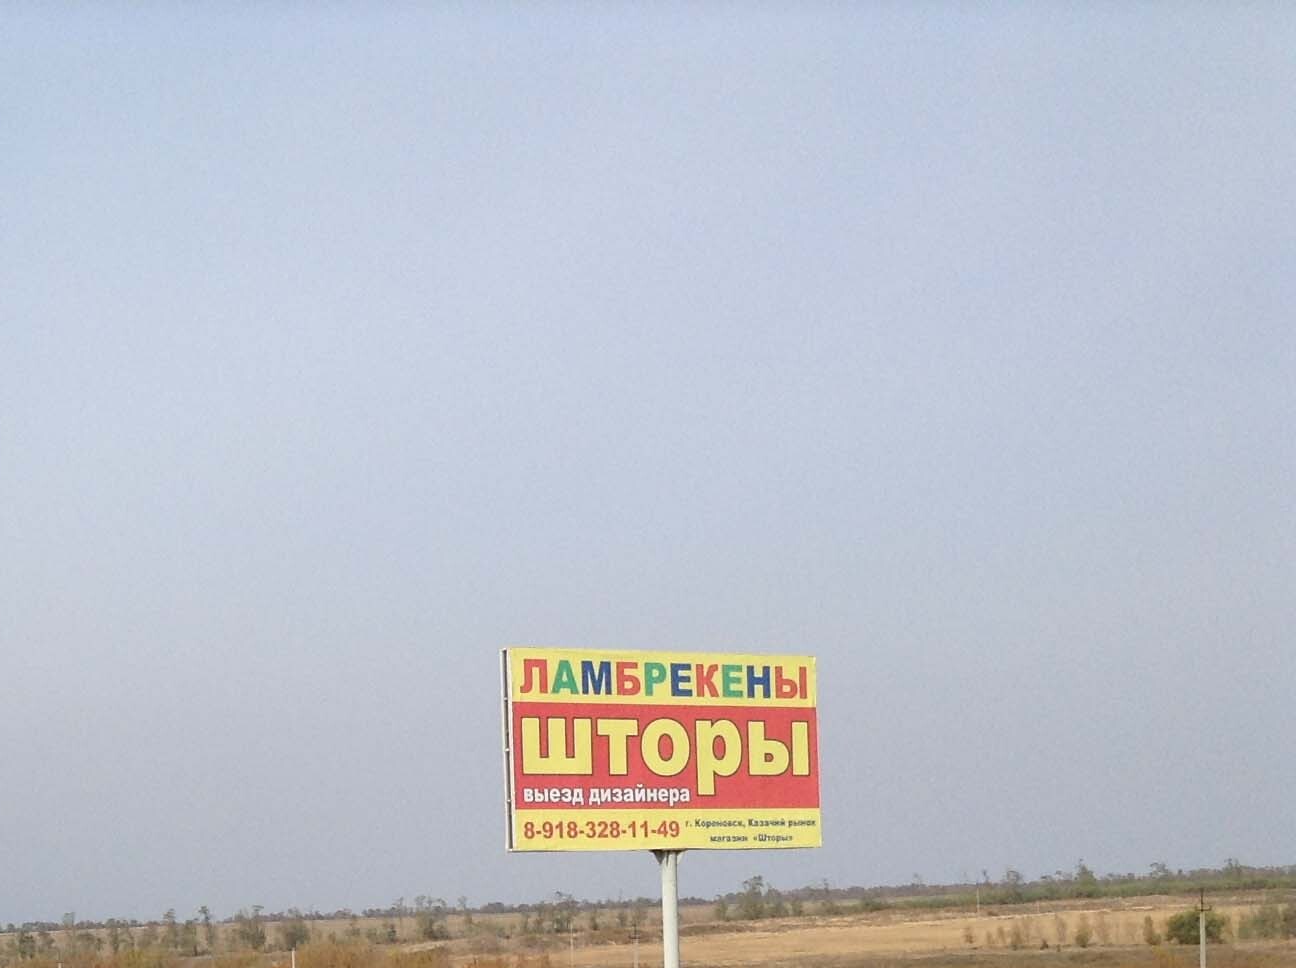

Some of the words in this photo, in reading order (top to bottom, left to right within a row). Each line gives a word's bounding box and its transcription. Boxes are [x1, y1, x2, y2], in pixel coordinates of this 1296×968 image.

[520, 659, 808, 699] ЛАМБРЕКЕНЫ
[523, 787, 584, 805] выезд
[588, 784, 691, 806] дизайнера
[523, 820, 680, 839] 8-918-328-11-49
